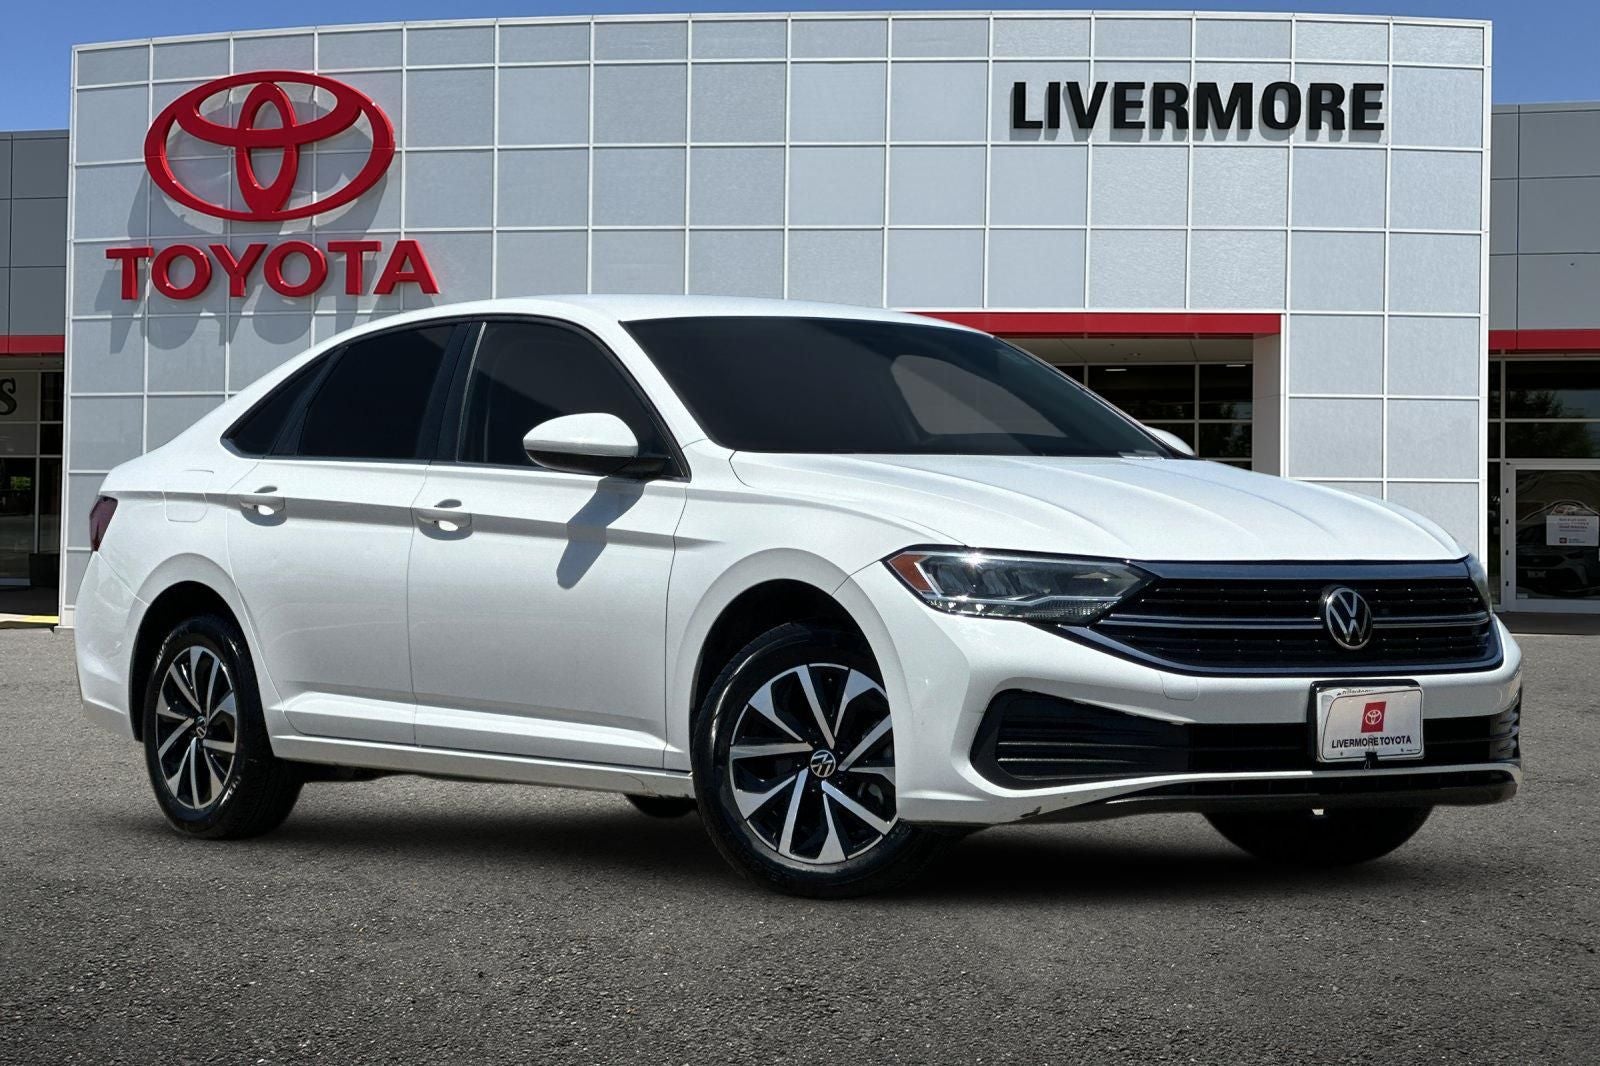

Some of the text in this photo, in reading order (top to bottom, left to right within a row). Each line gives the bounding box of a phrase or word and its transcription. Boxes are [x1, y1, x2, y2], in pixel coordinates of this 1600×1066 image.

[1012, 81, 1385, 131] LIVERMORE
[105, 240, 440, 300] TOYOTA
[1331, 735, 1412, 749] LIVERMORE TOYOTA
